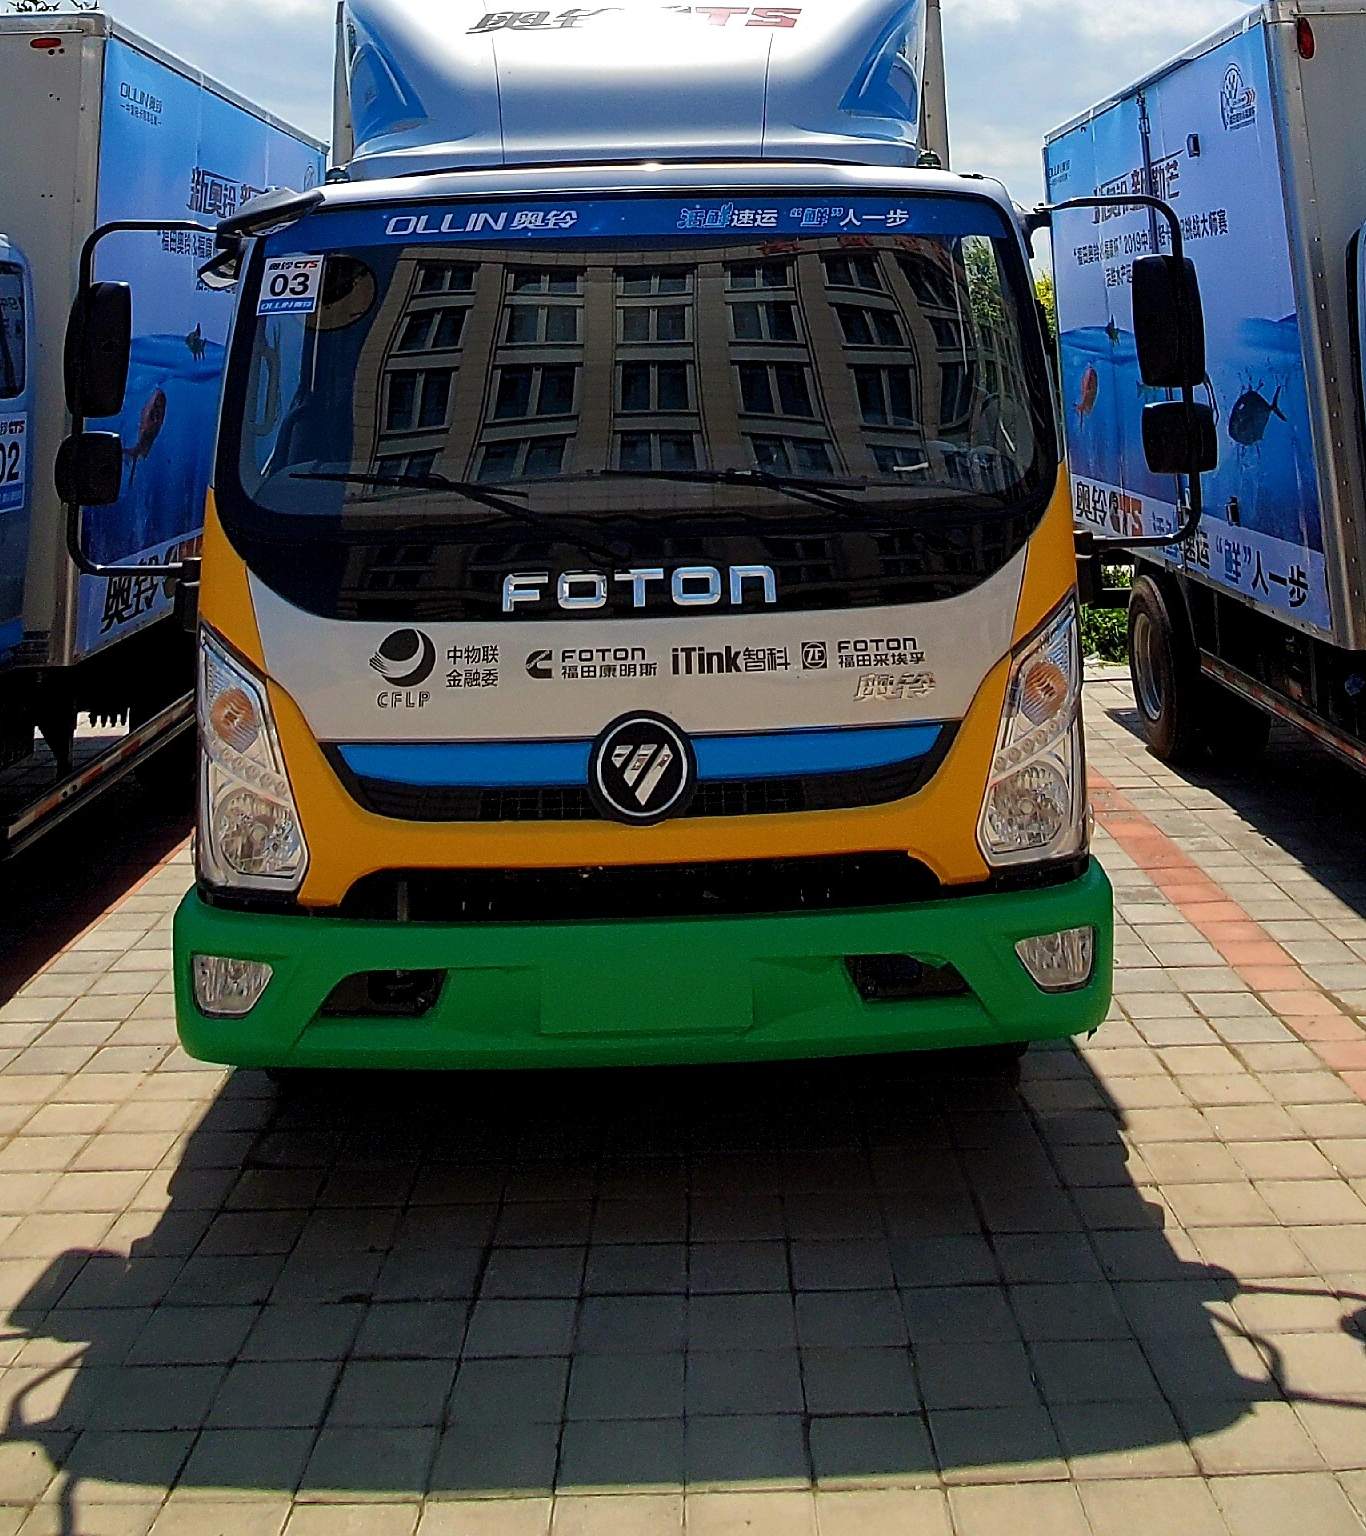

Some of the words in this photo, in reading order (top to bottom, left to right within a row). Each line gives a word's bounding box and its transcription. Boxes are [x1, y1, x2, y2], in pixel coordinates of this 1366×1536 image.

[269, 272, 311, 298] 03
[501, 565, 777, 612] FOTON
[445, 644, 500, 666] 中物联
[561, 647, 647, 663] FOTON
[837, 636, 918, 654] FOTON
[671, 644, 792, 676] iTink智科
[838, 650, 926, 669] 福田采埃孚
[445, 668, 500, 689] 金融委
[561, 662, 658, 680] 福田康明斯
[376, 691, 431, 709] CFLP
